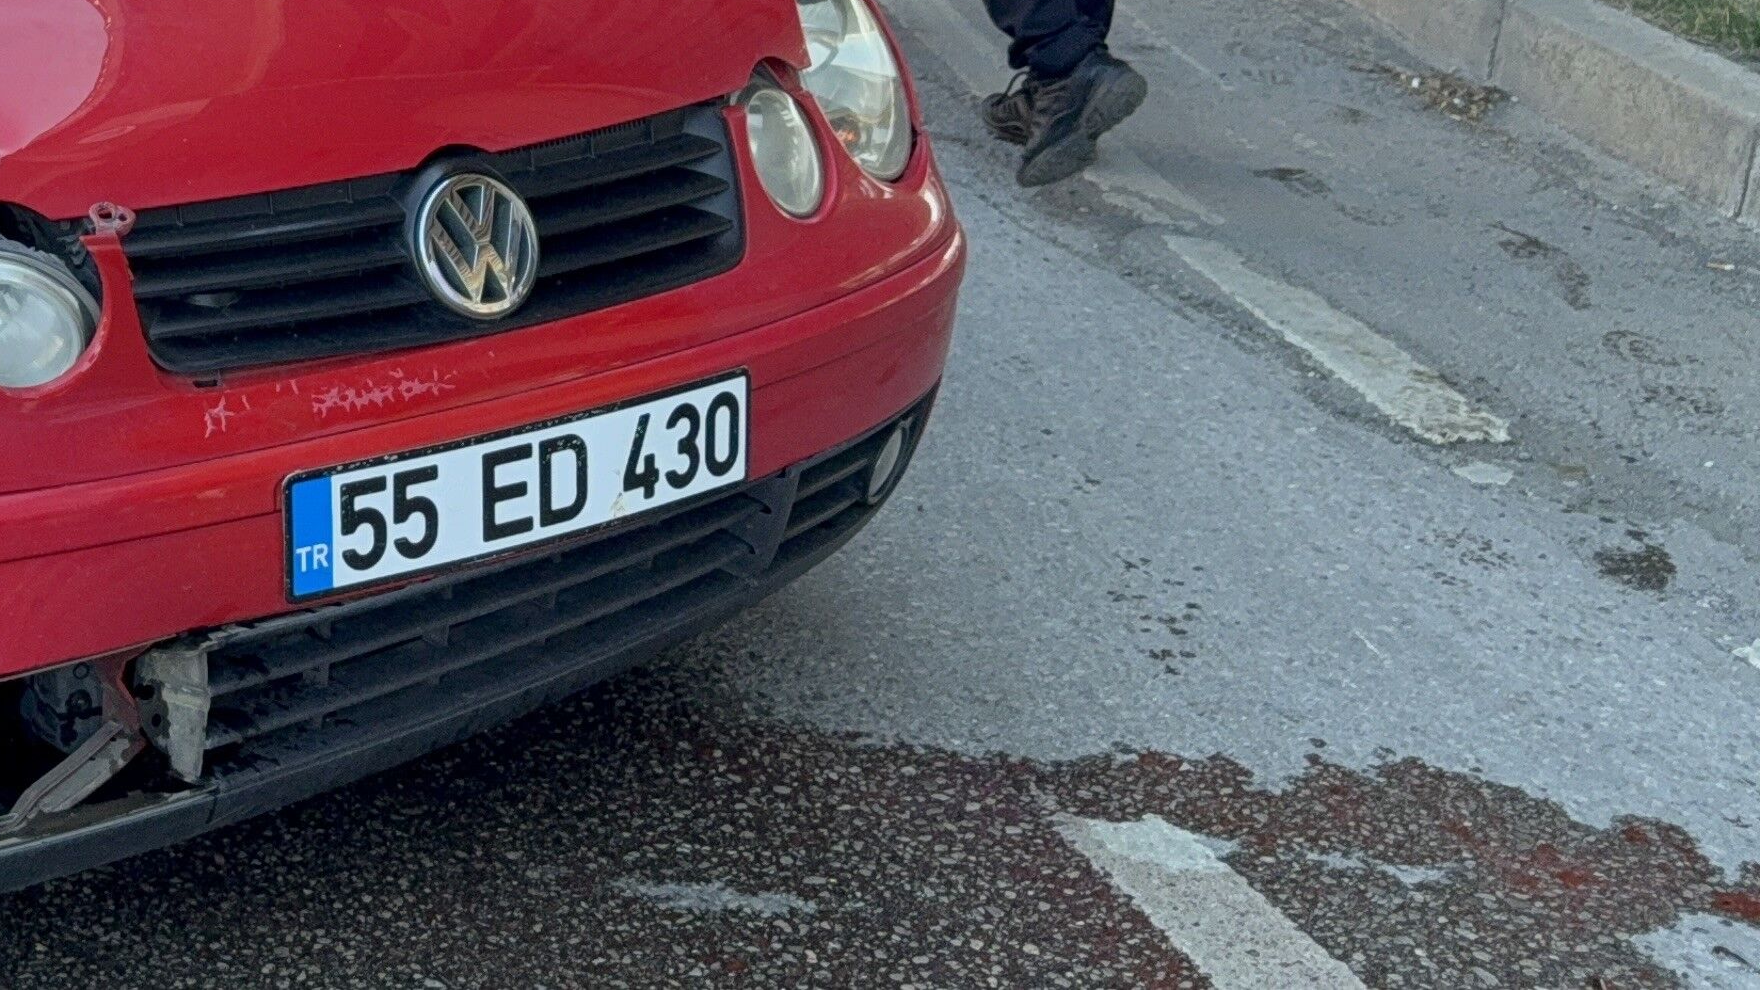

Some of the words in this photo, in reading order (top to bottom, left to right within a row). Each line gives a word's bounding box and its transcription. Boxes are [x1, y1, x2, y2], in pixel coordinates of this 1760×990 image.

[339, 464, 440, 571] 55
[481, 433, 589, 543] ED
[622, 390, 740, 500] 430
[295, 543, 329, 574] TR
